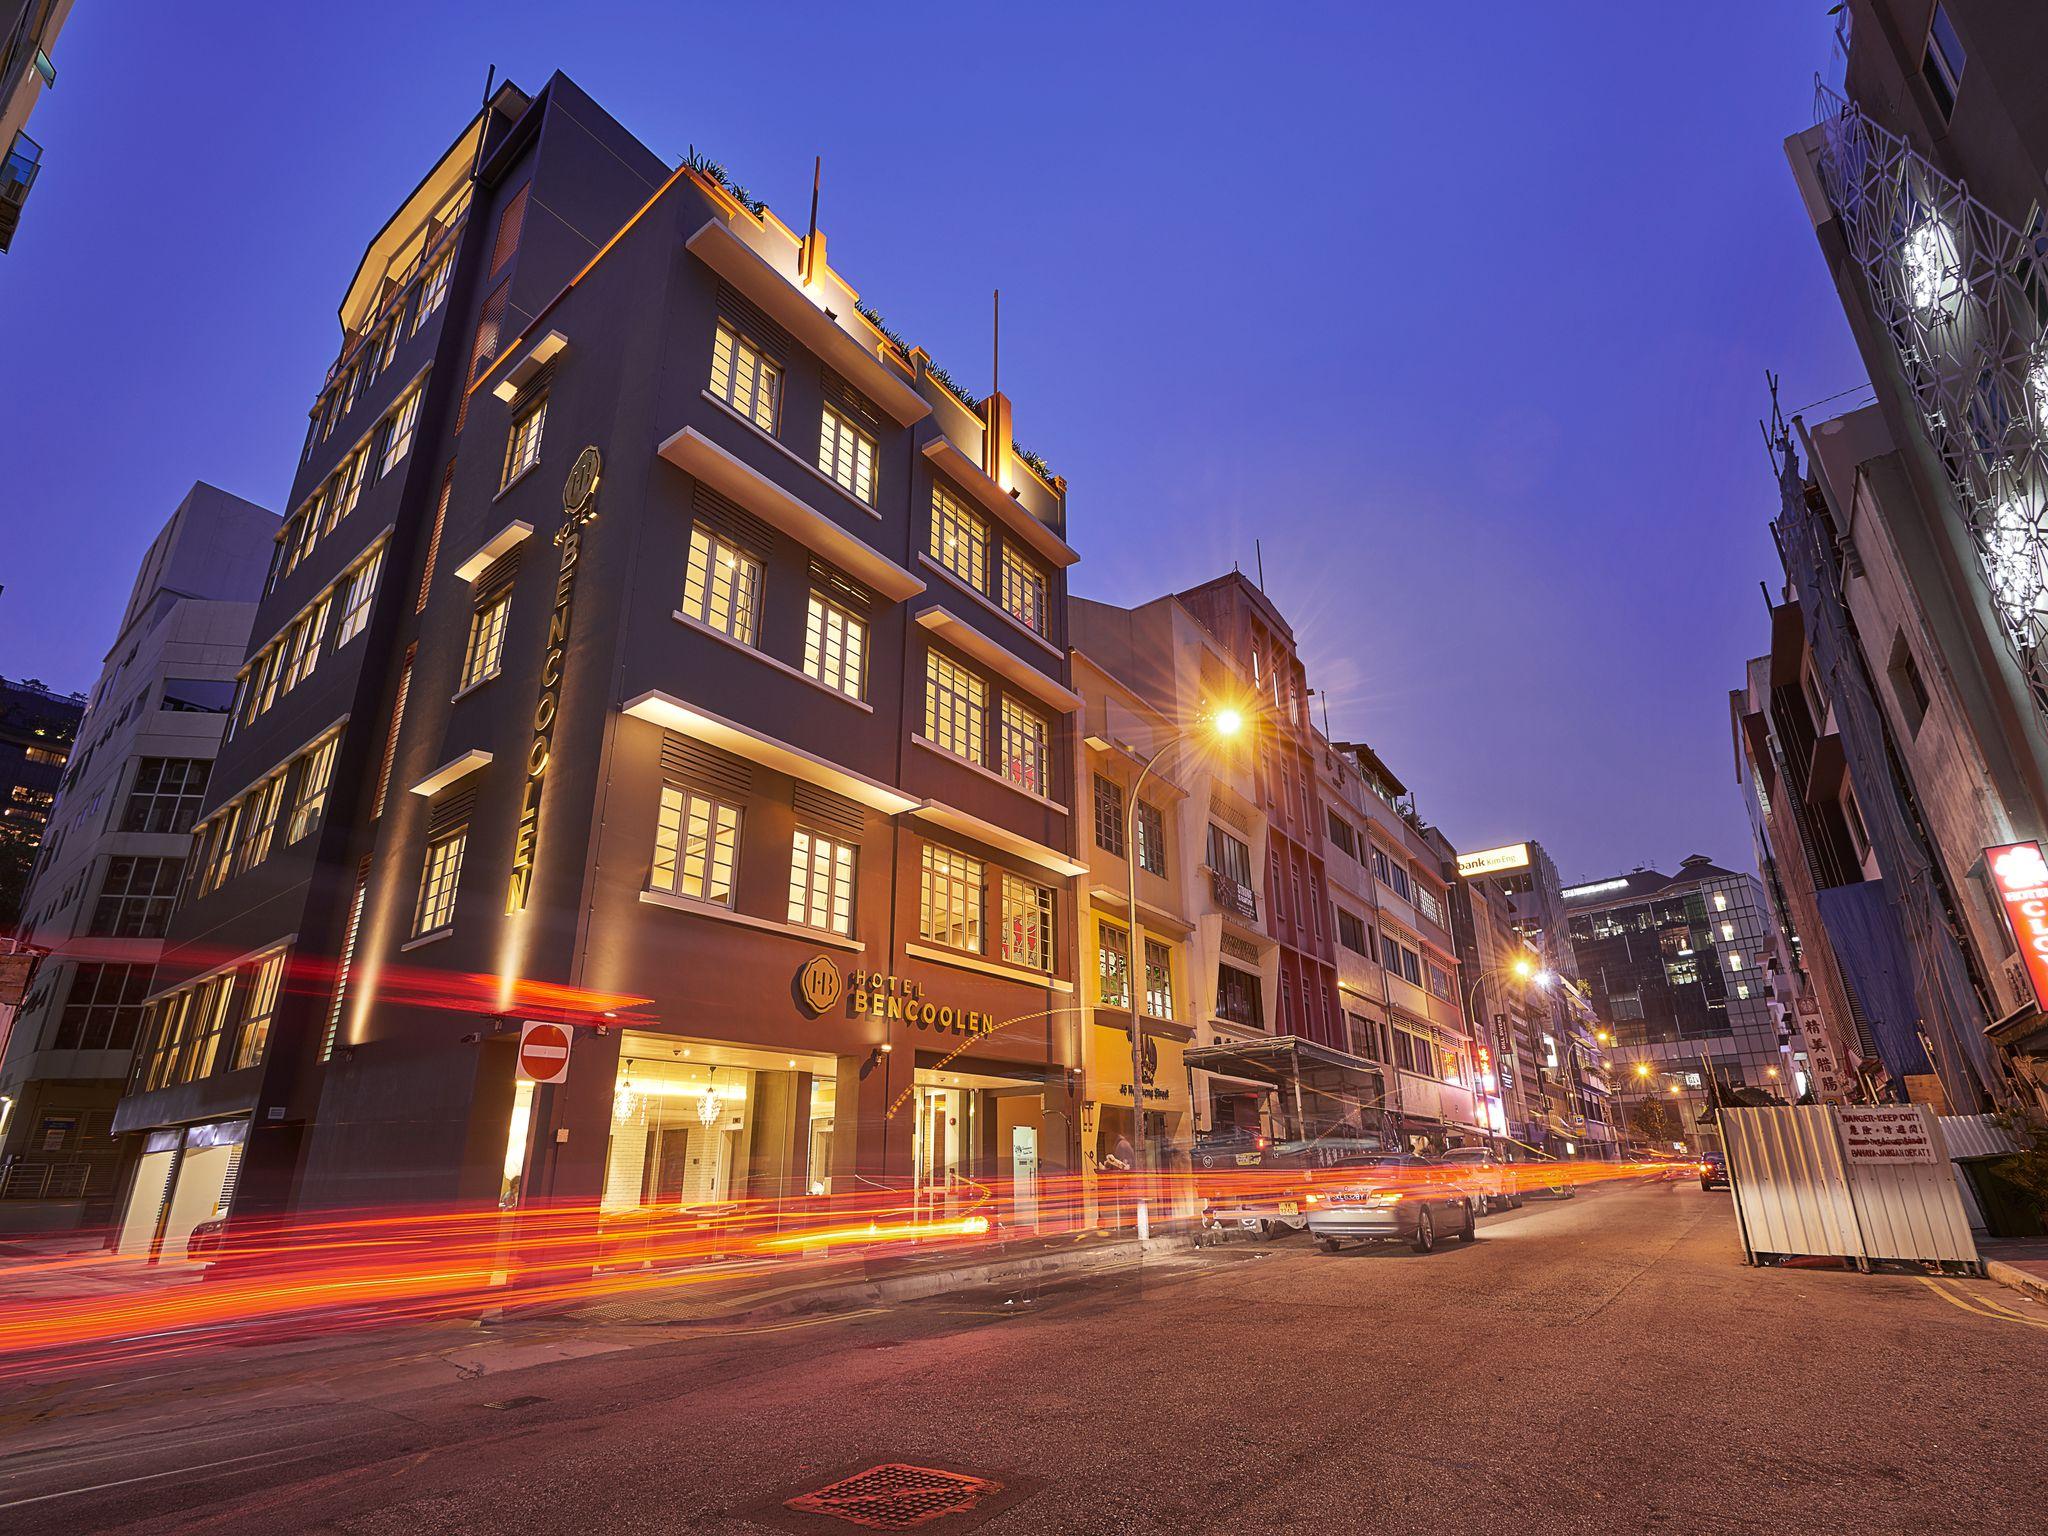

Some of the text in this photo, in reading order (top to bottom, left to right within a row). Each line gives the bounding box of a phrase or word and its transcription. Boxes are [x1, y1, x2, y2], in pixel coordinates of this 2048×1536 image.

[553, 503, 598, 546] HOTEL
[504, 533, 583, 917] BENCOOLEN
[856, 969, 925, 997] HOTEL
[855, 989, 993, 1034] BENCOOLEN
[1900, 1113, 1920, 1122] OUT!
